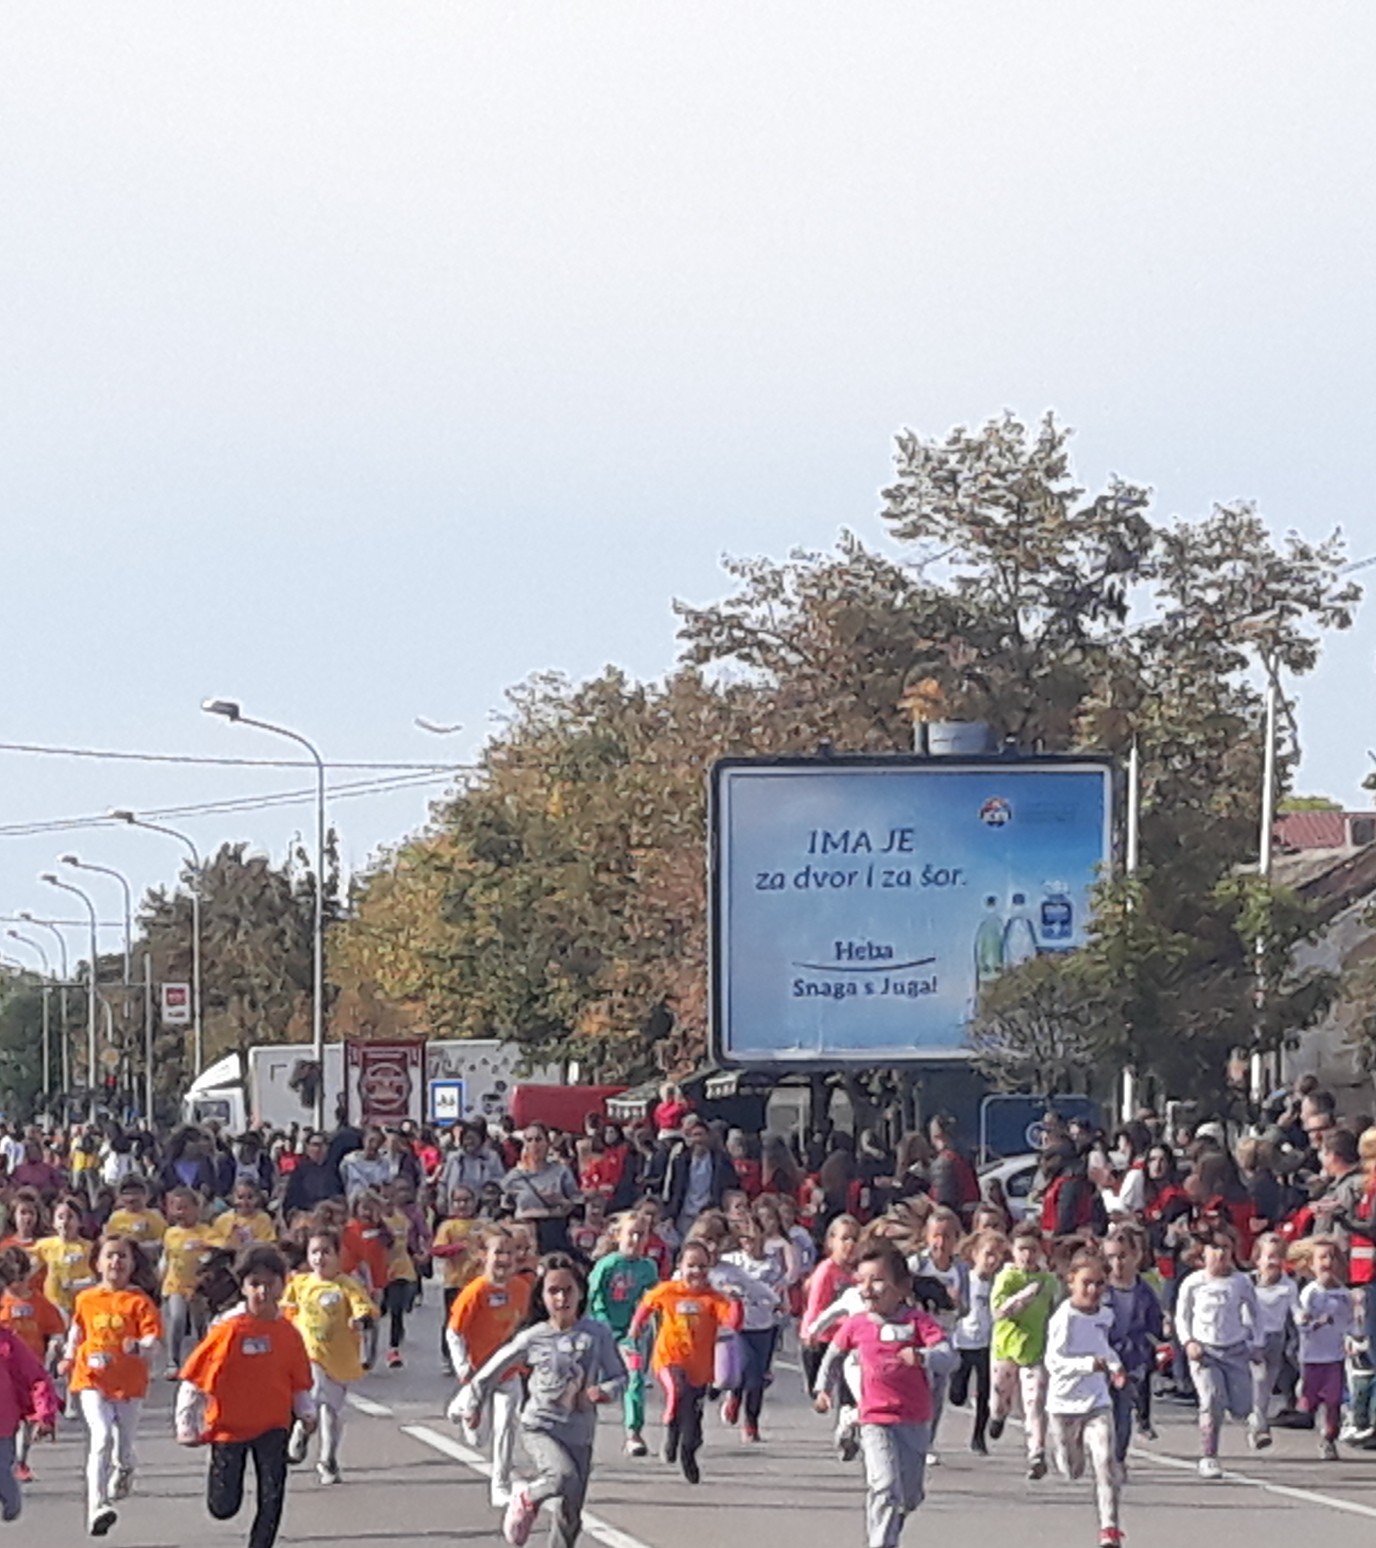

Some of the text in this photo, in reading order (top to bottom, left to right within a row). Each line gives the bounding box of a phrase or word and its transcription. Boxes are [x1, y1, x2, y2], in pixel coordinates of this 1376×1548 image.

[807, 828, 915, 854] IMA JE
[755, 871, 785, 891] za
[793, 865, 859, 889] dvor
[881, 869, 912, 888] za
[920, 863, 967, 887] šor.
[834, 940, 894, 961] Heba
[792, 975, 938, 1000] Snaga s Juga!
